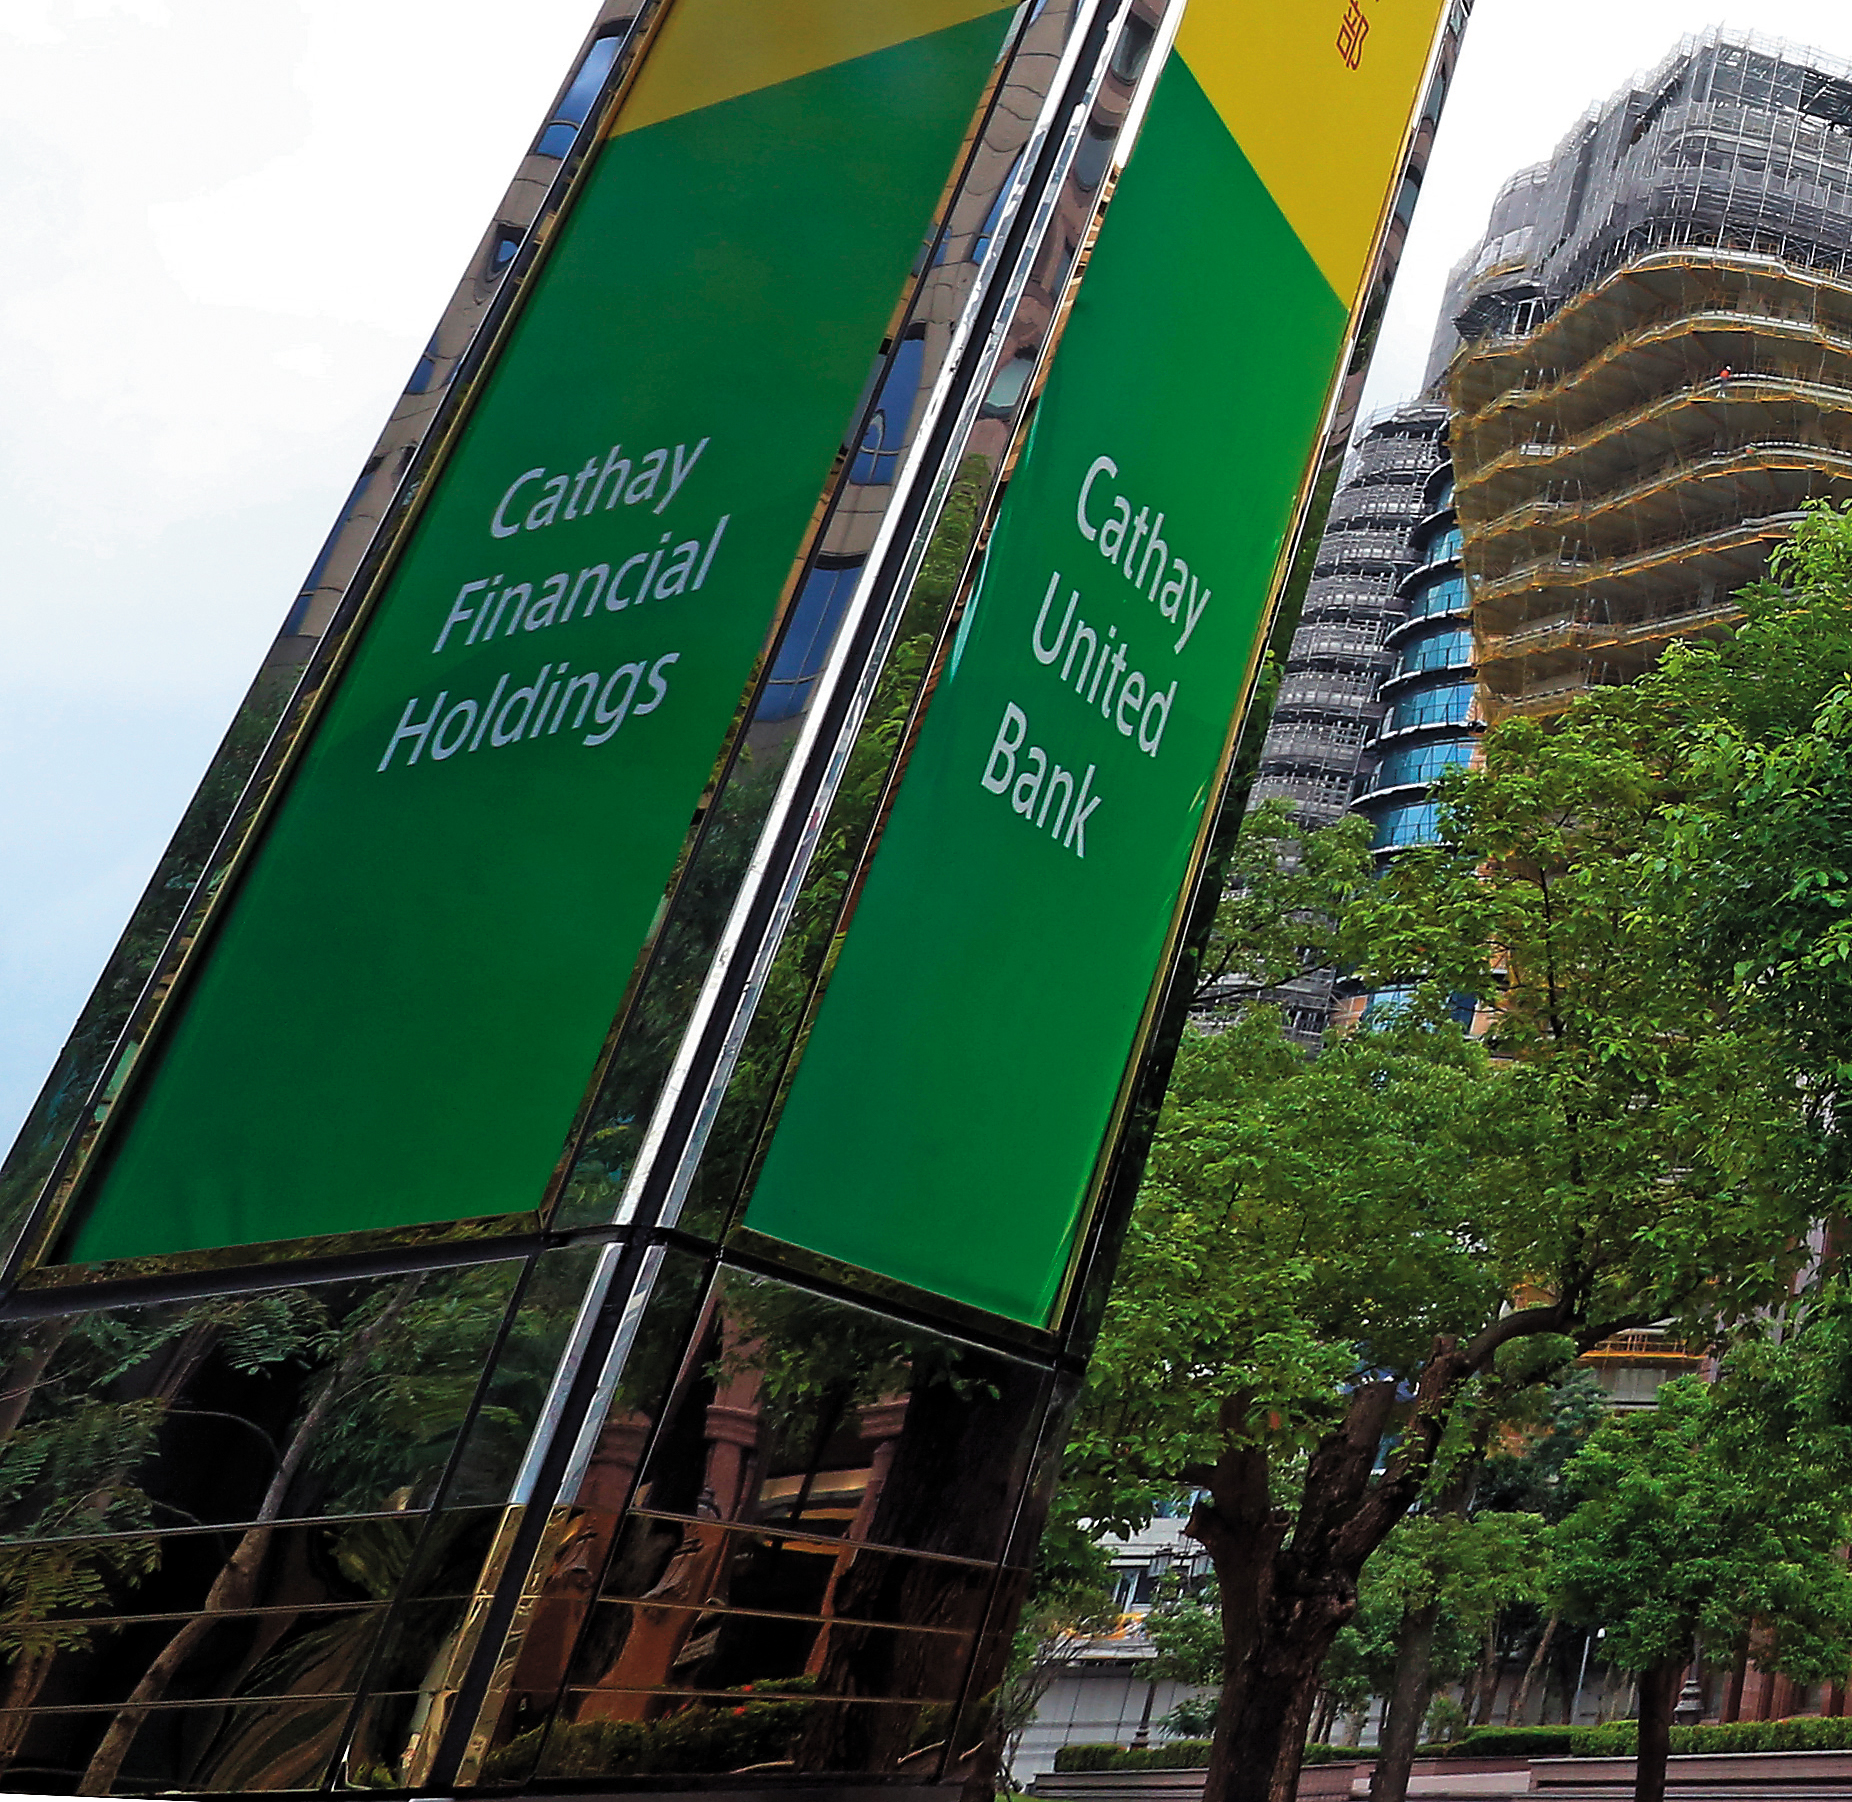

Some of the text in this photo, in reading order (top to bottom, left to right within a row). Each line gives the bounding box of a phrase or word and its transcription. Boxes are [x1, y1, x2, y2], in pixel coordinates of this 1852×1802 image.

[490, 437, 711, 539] Cathay
[1077, 455, 1212, 655] Cathay
[432, 514, 731, 654] Financial
[376, 652, 681, 773] Holdings
[1032, 571, 1178, 758] United
[981, 701, 1102, 859] Bank
